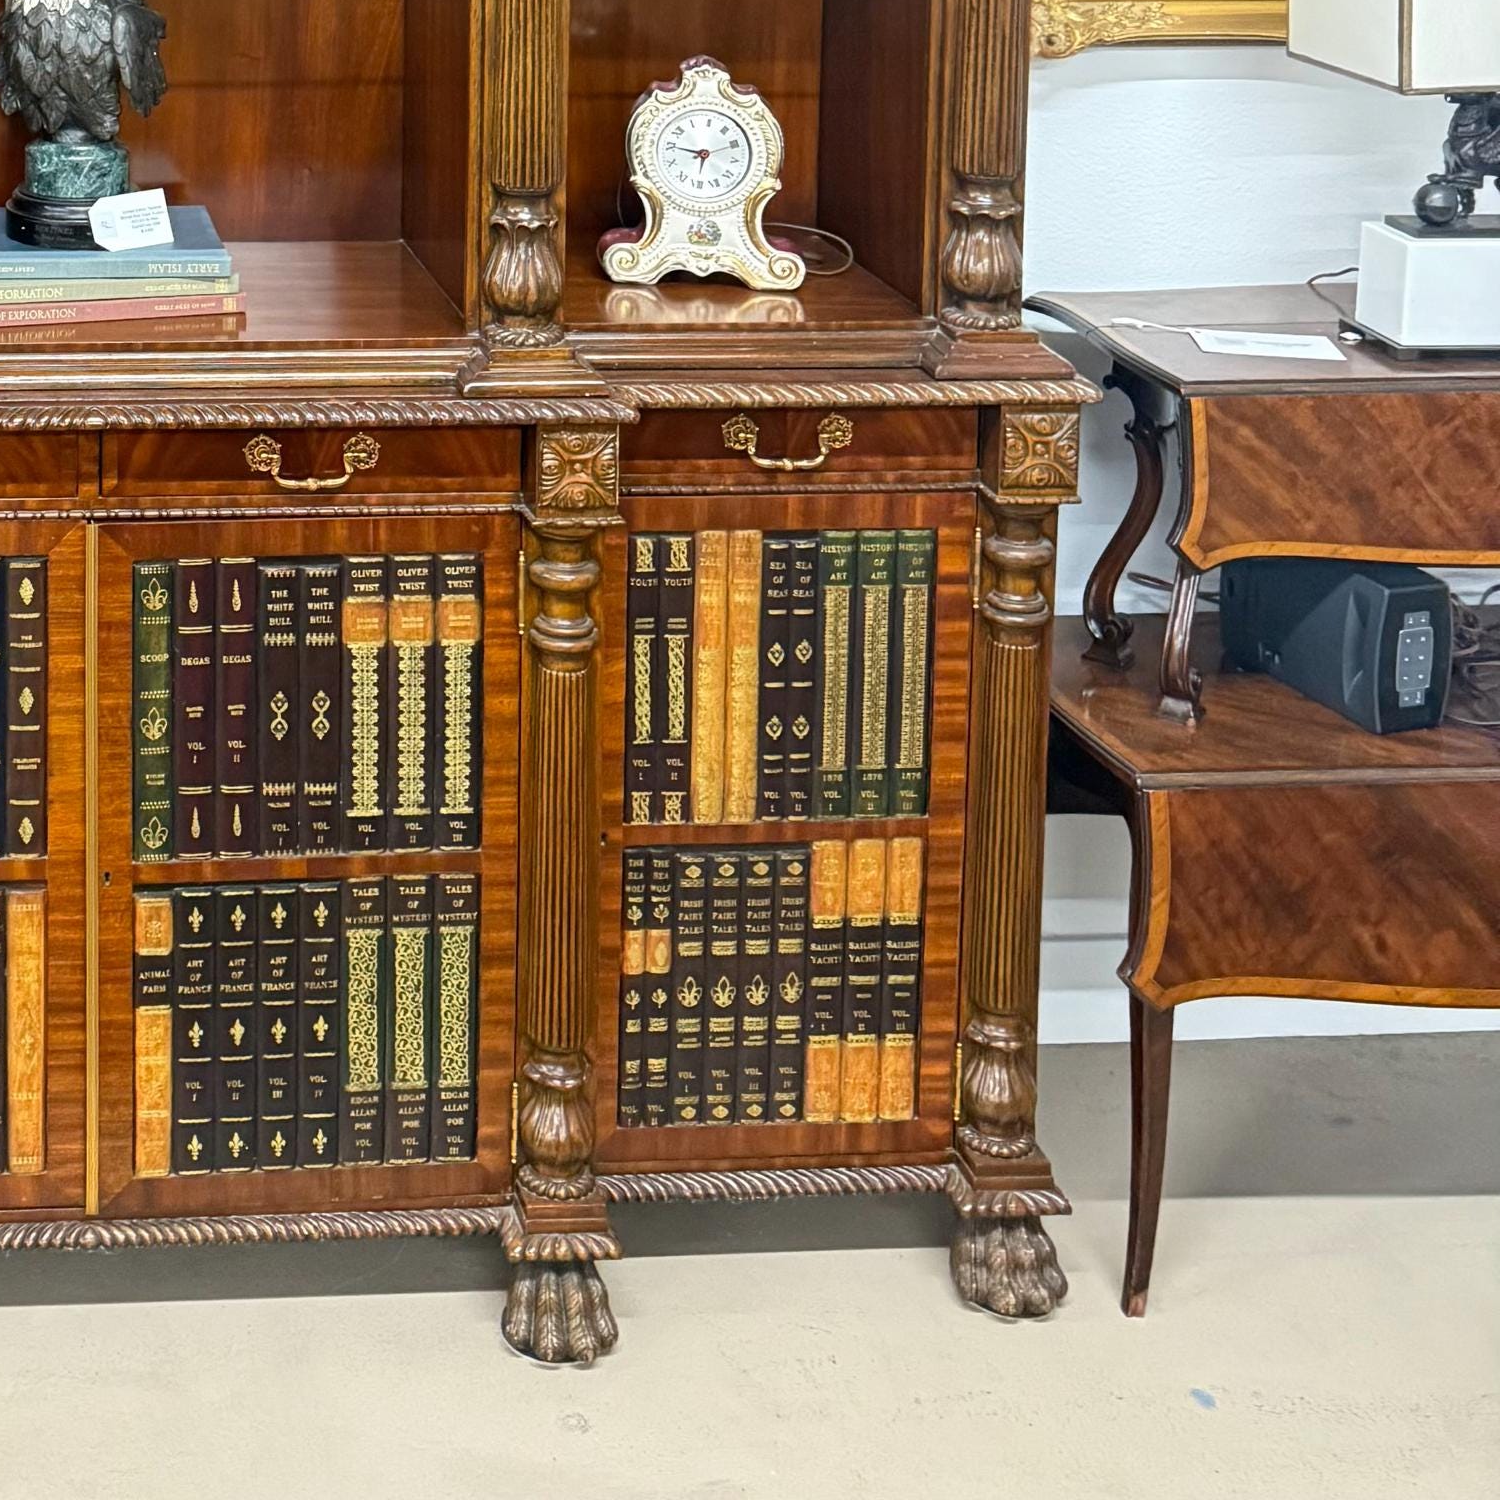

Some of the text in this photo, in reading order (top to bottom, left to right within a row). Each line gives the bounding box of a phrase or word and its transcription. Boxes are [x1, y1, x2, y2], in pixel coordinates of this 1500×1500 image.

[149, 264, 219, 273] EARLY ISLAM
[9, 308, 76, 320] EXPLORATION
[835, 558, 846, 567] OF
[874, 558, 885, 566] OF
[912, 557, 923, 565] OF
[351, 569, 382, 578] OLIVER
[397, 568, 428, 577] OLIVER
[445, 566, 476, 575] OLIVER
[909, 570, 926, 578] ART
[800, 575, 810, 583] OF
[830, 572, 847, 580] ART
[871, 571, 887, 579] ART
[773, 575, 783, 584] OF
[354, 583, 379, 592] TWIST
[400, 582, 425, 591] TWIST
[448, 580, 472, 588] TWIST
[271, 589, 288, 598] THE
[311, 588, 329, 596] THE
[267, 603, 294, 611] WHITE
[308, 602, 334, 610] WHITE
[270, 617, 292, 626] BULL
[310, 616, 332, 624] BULL
[141, 654, 169, 664] SCOOP
[181, 657, 210, 665] DEGAS
[223, 655, 252, 664] DEGAS
[353, 888, 379, 897] TALES
[399, 887, 426, 895] TALES
[445, 885, 472, 894] TALES
[360, 903, 371, 911] OF
[407, 901, 419, 909] OF
[453, 900, 464, 908] OF
[228, 958, 245, 967] ART
[270, 957, 287, 965] ART
[311, 954, 328, 963] ART
[186, 959, 203, 968] ART
[232, 972, 243, 980] OF
[272, 970, 284, 978] OF
[314, 968, 326, 976] OF
[190, 973, 201, 981] OF
[143, 985, 166, 994] FARM
[350, 1095, 378, 1104] EDGAR
[397, 1094, 426, 1103] EDGAR
[441, 1092, 469, 1100] EDGAR
[398, 1107, 424, 1115] ALLAN
[442, 1104, 468, 1113] ALLAN
[350, 1109, 377, 1117] ALLAN
[447, 1117, 464, 1126] POE
[355, 1122, 372, 1130] POE
